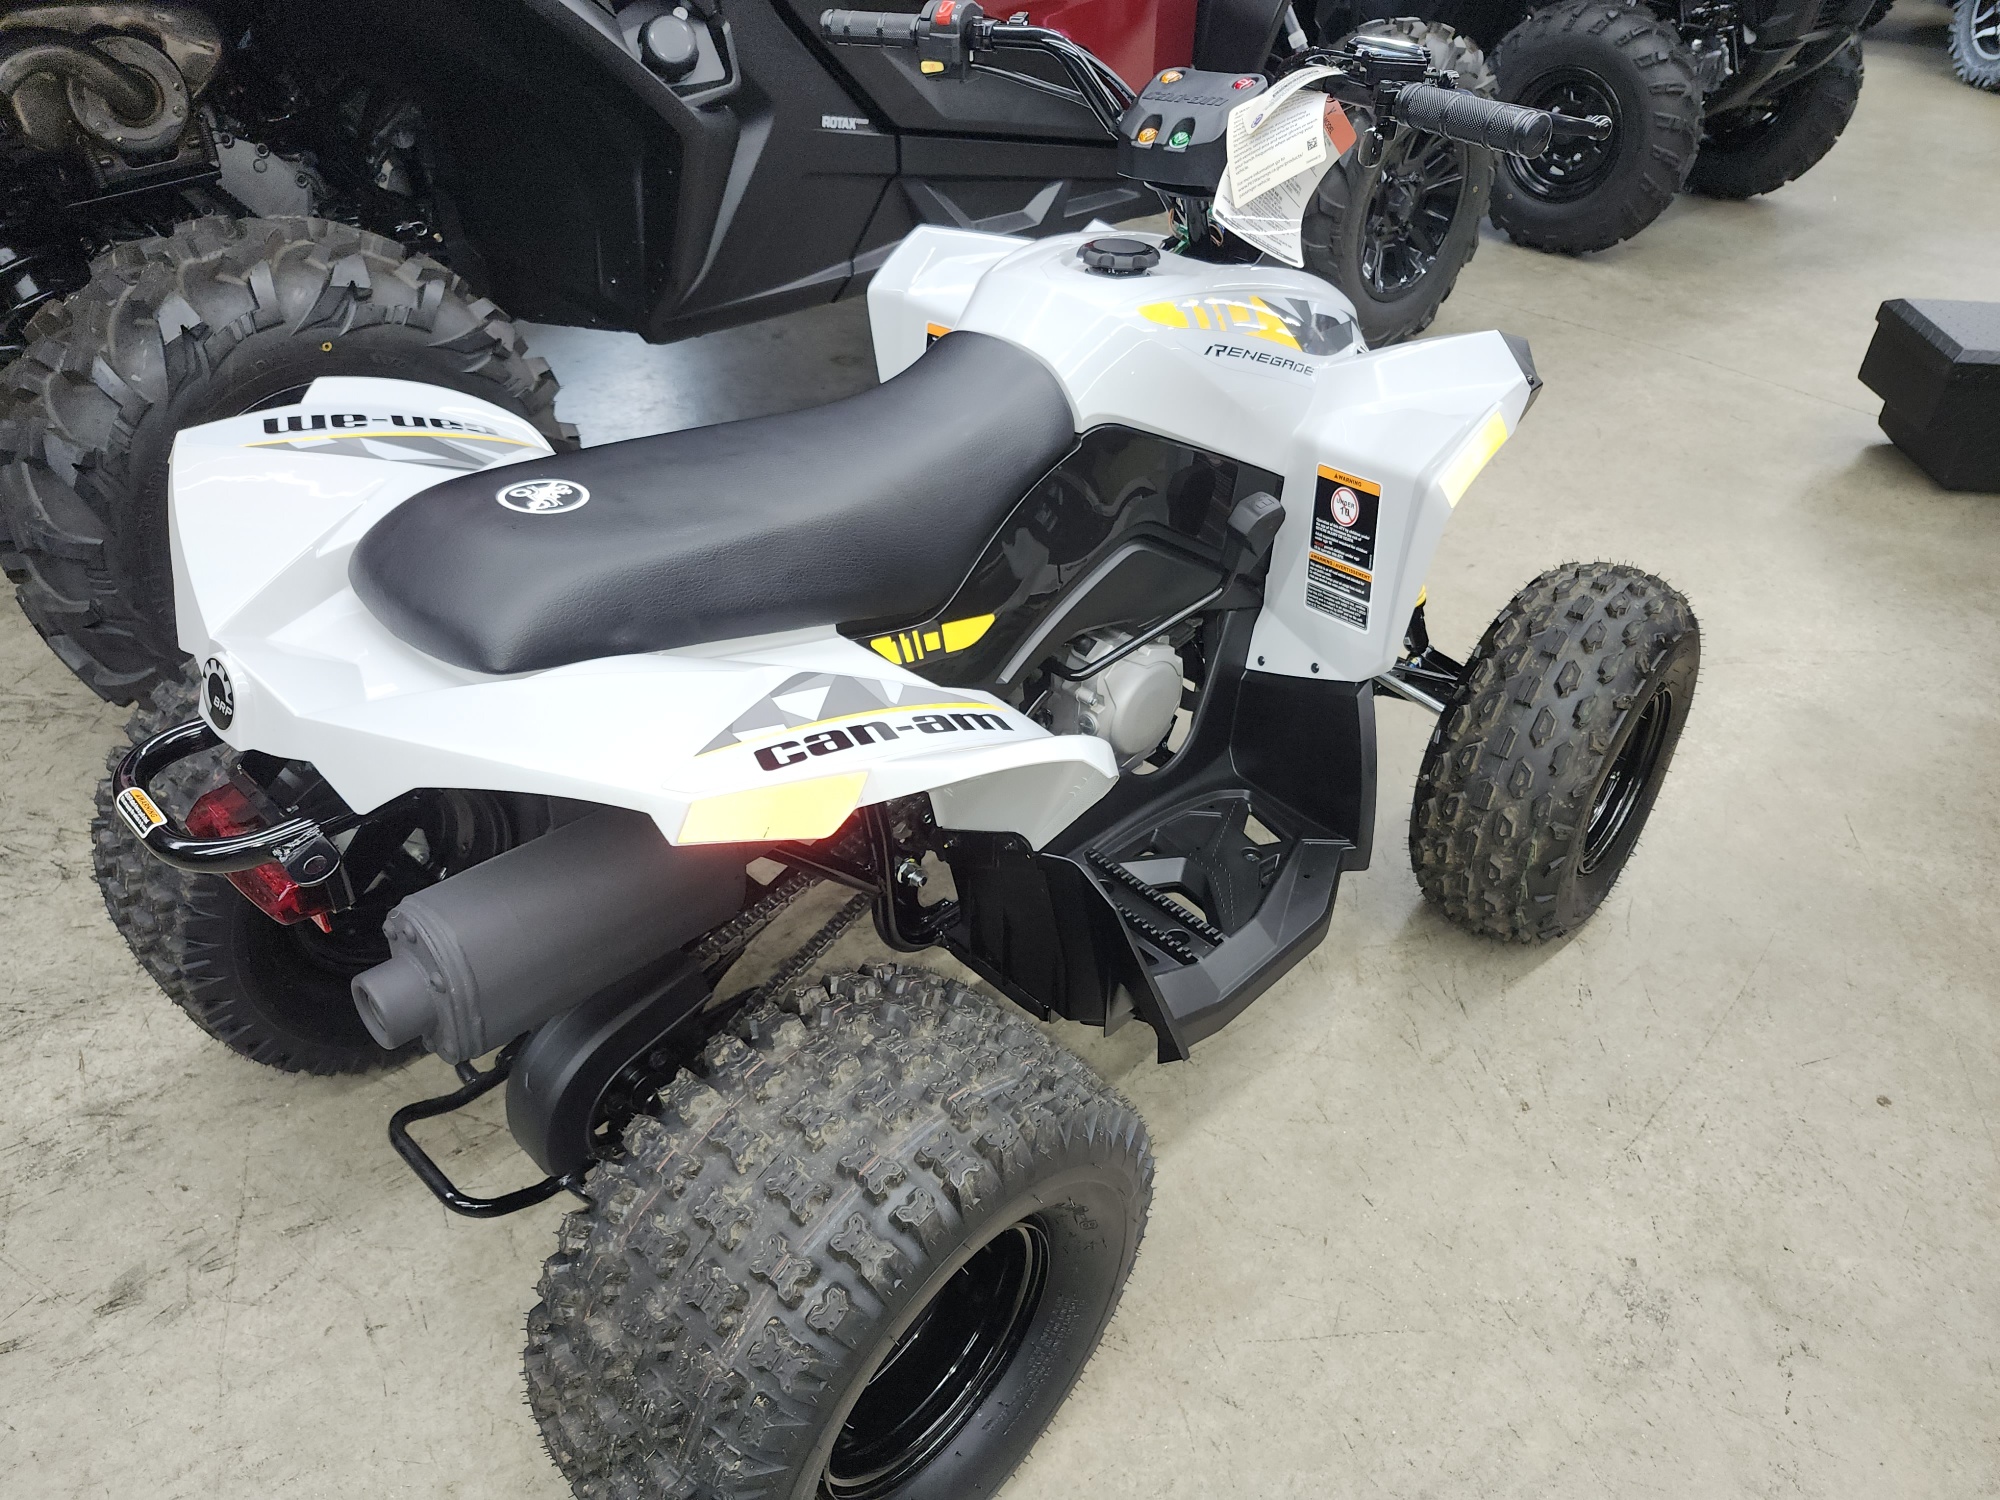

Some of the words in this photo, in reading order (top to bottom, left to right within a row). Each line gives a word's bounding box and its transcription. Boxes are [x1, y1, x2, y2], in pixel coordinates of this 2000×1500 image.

[821, 115, 857, 130] ROTAX
[1204, 343, 1315, 376] RENEGADE
[1338, 474, 1362, 487] WARNING
[1336, 498, 1355, 509] UNDER
[213, 695, 233, 716] BRP
[753, 713, 1015, 771] can-am
[139, 794, 158, 818] WARNING
